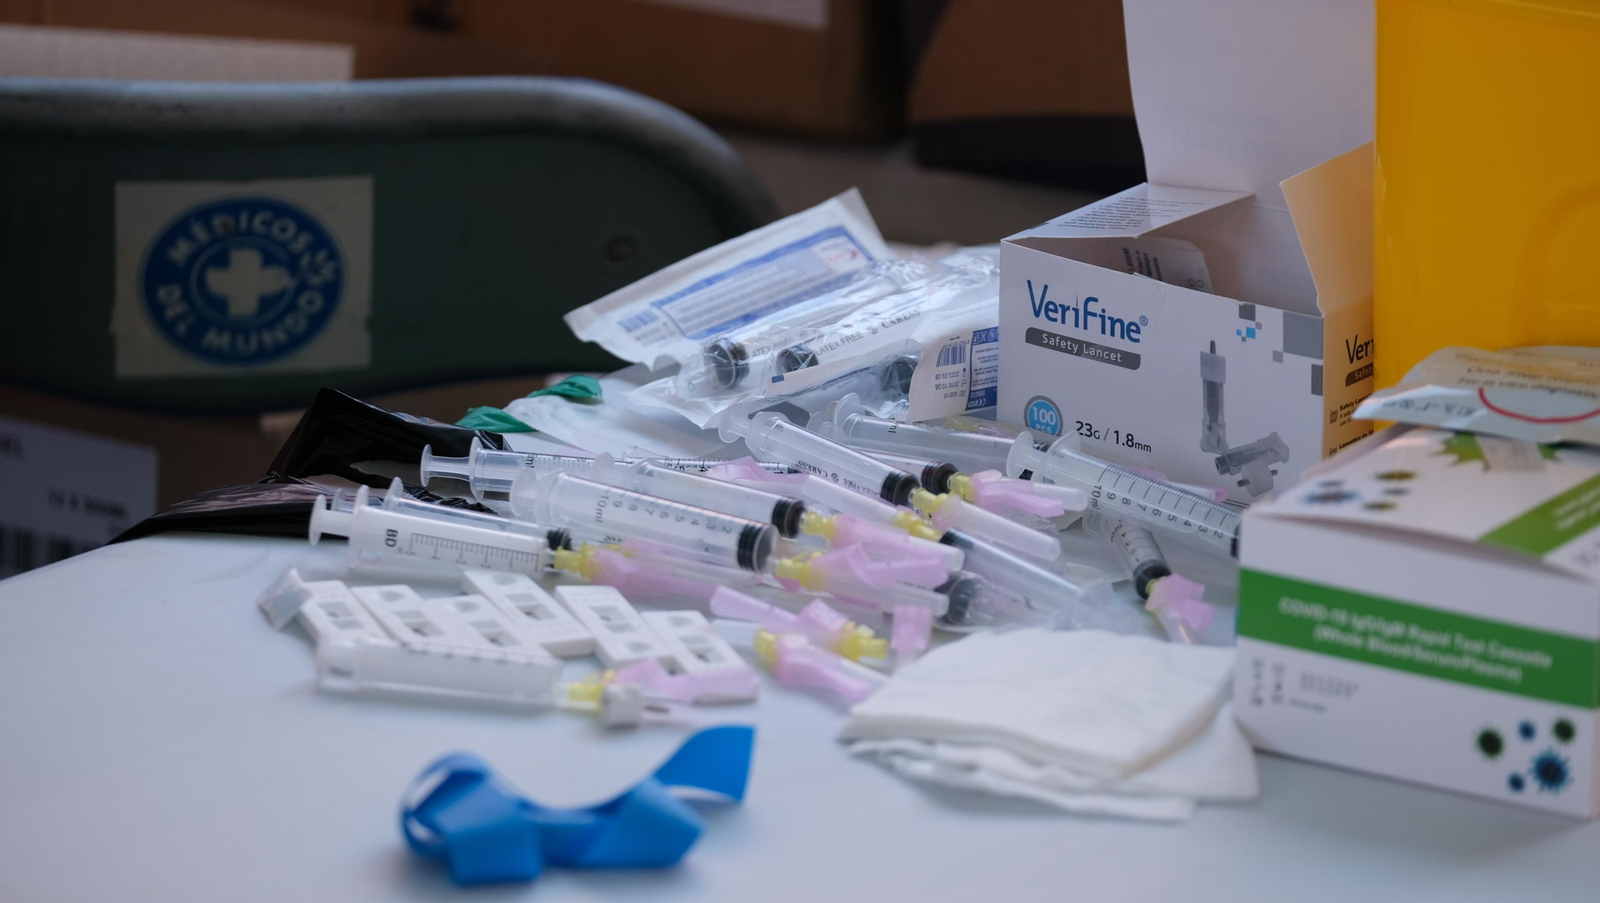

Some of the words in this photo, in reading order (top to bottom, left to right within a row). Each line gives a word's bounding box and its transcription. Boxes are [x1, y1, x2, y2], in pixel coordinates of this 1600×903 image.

[167, 210, 314, 267] MÉDICOS
[156, 284, 195, 336] DEL
[203, 290, 323, 353] MUNDO
[815, 341, 840, 356] LATEX
[841, 331, 864, 345] FREE
[1042, 333, 1079, 354] Safety
[1083, 343, 1122, 362] Lancet
[1032, 406, 1057, 426] 100
[1035, 423, 1053, 434] PCS
[1076, 421, 1100, 440] 23G
[1103, 427, 1110, 441] /
[1113, 430, 1152, 453] 1.8mm
[1091, 484, 1102, 510] 10ml
[1106, 491, 1117, 500] 9
[1121, 497, 1132, 506] 8
[1137, 502, 1147, 511] 7
[1152, 508, 1162, 517] 6
[1167, 514, 1178, 523] 5
[1183, 519, 1193, 528] 4
[1198, 525, 1208, 533] 3
[1213, 530, 1224, 539] 2
[385, 528, 398, 548] BD
